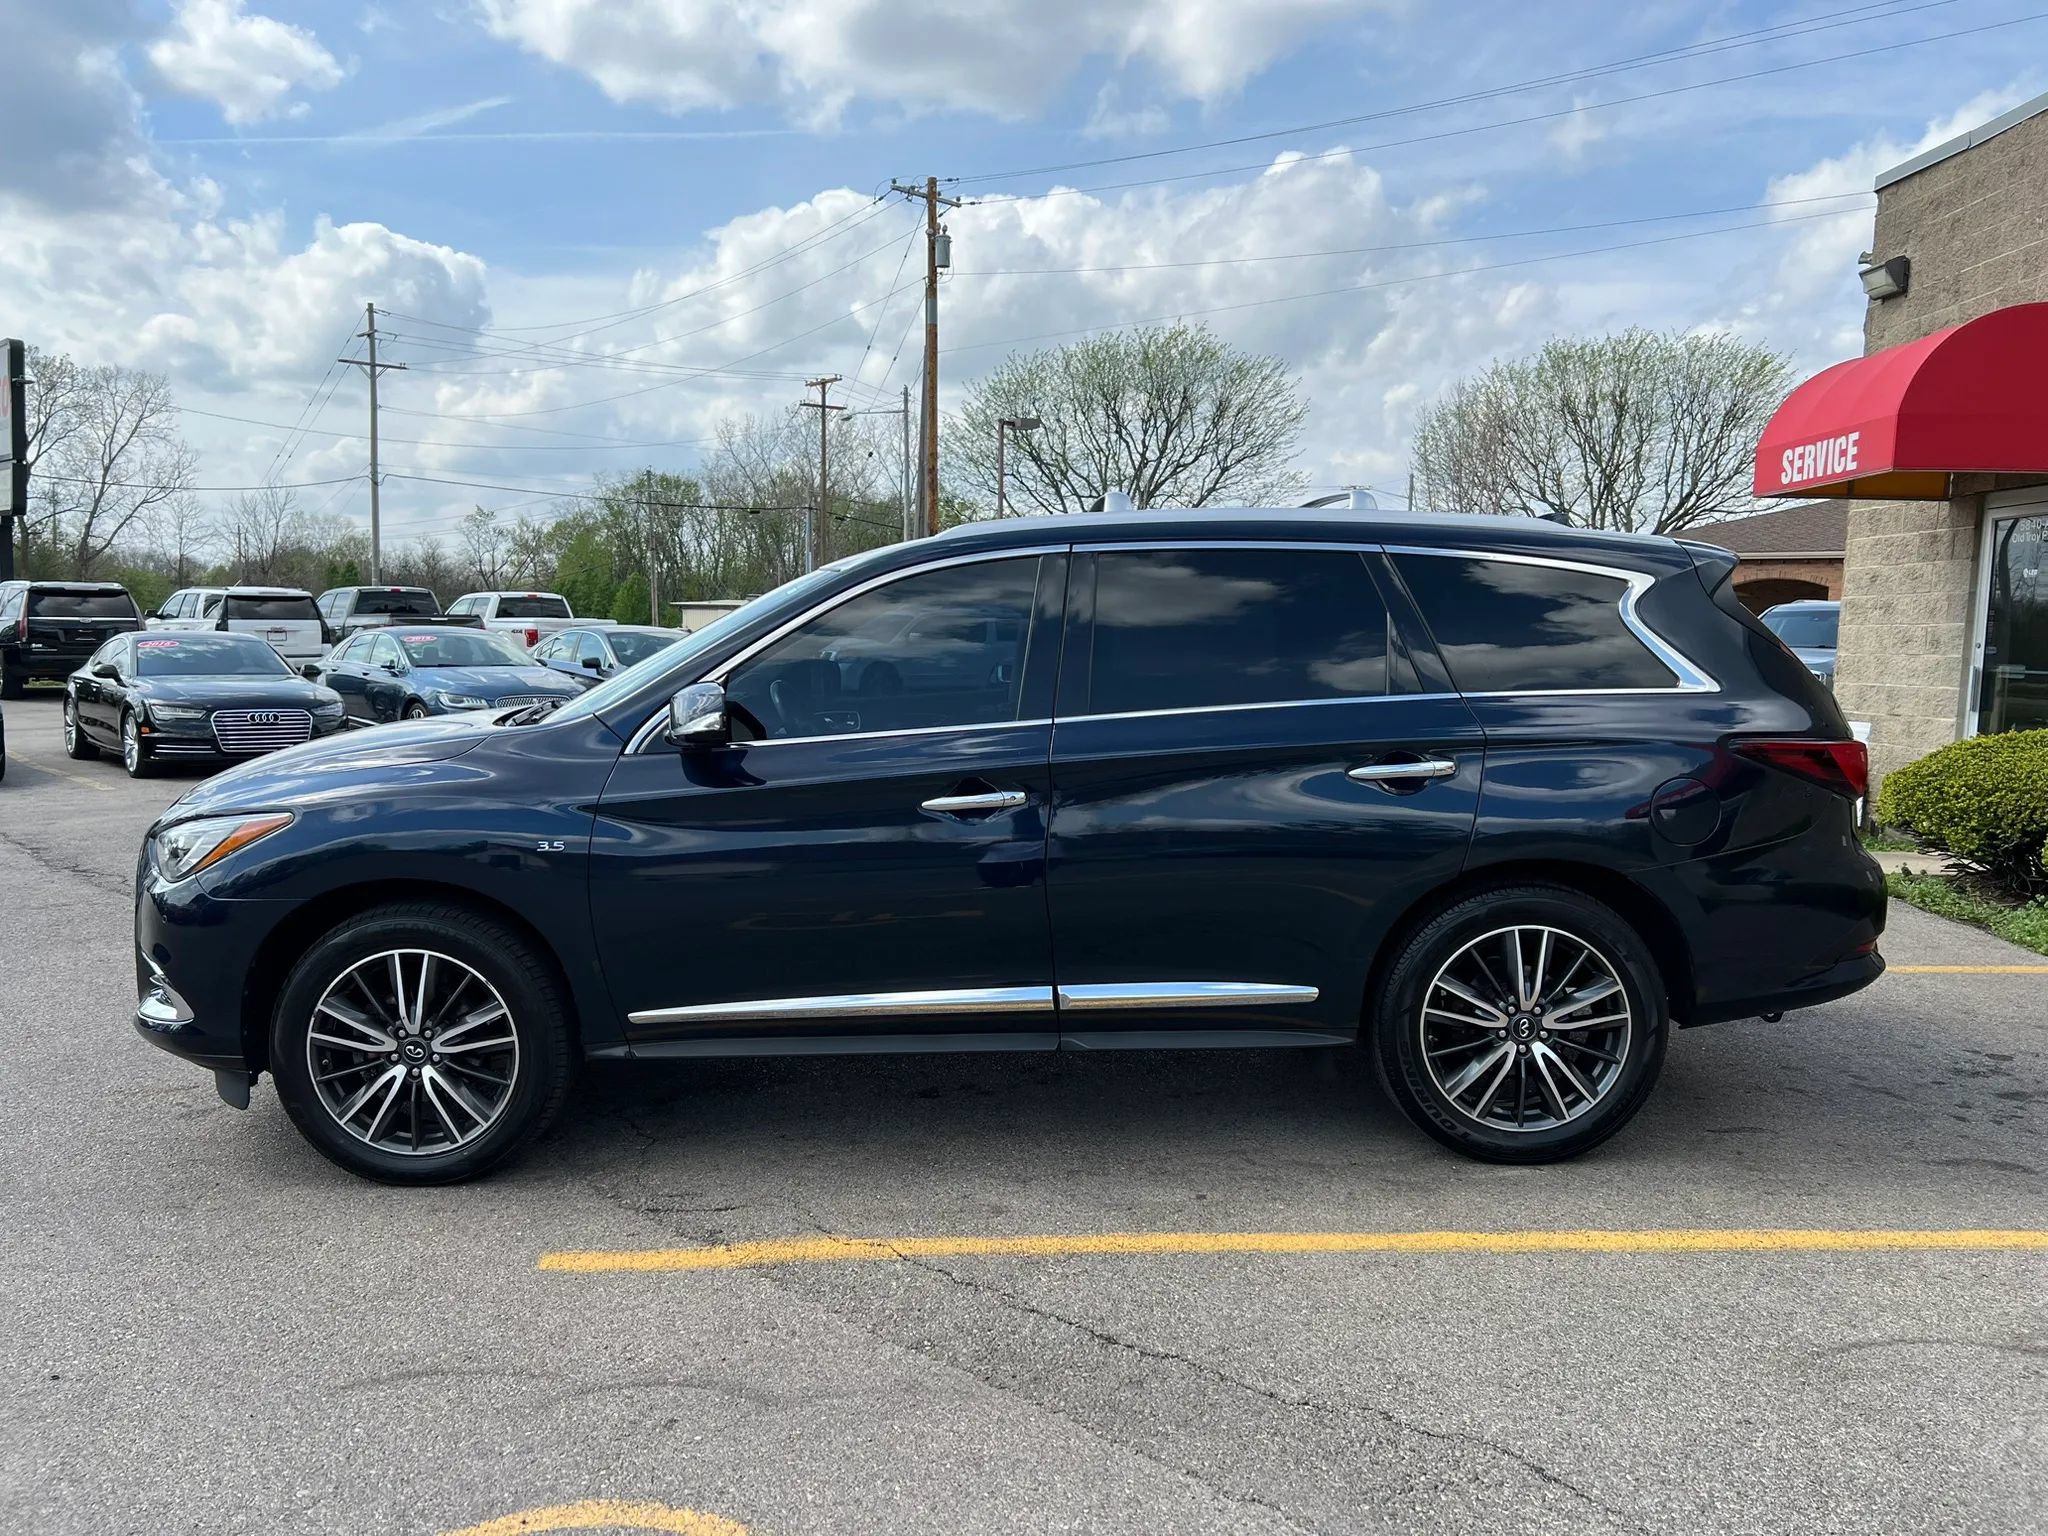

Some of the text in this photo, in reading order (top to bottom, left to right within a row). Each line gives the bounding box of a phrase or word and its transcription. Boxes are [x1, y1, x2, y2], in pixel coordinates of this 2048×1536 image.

[1780, 431, 1860, 485] SERVICE
[2011, 533, 2024, 543] Old
[2026, 531, 2040, 543] Troy
